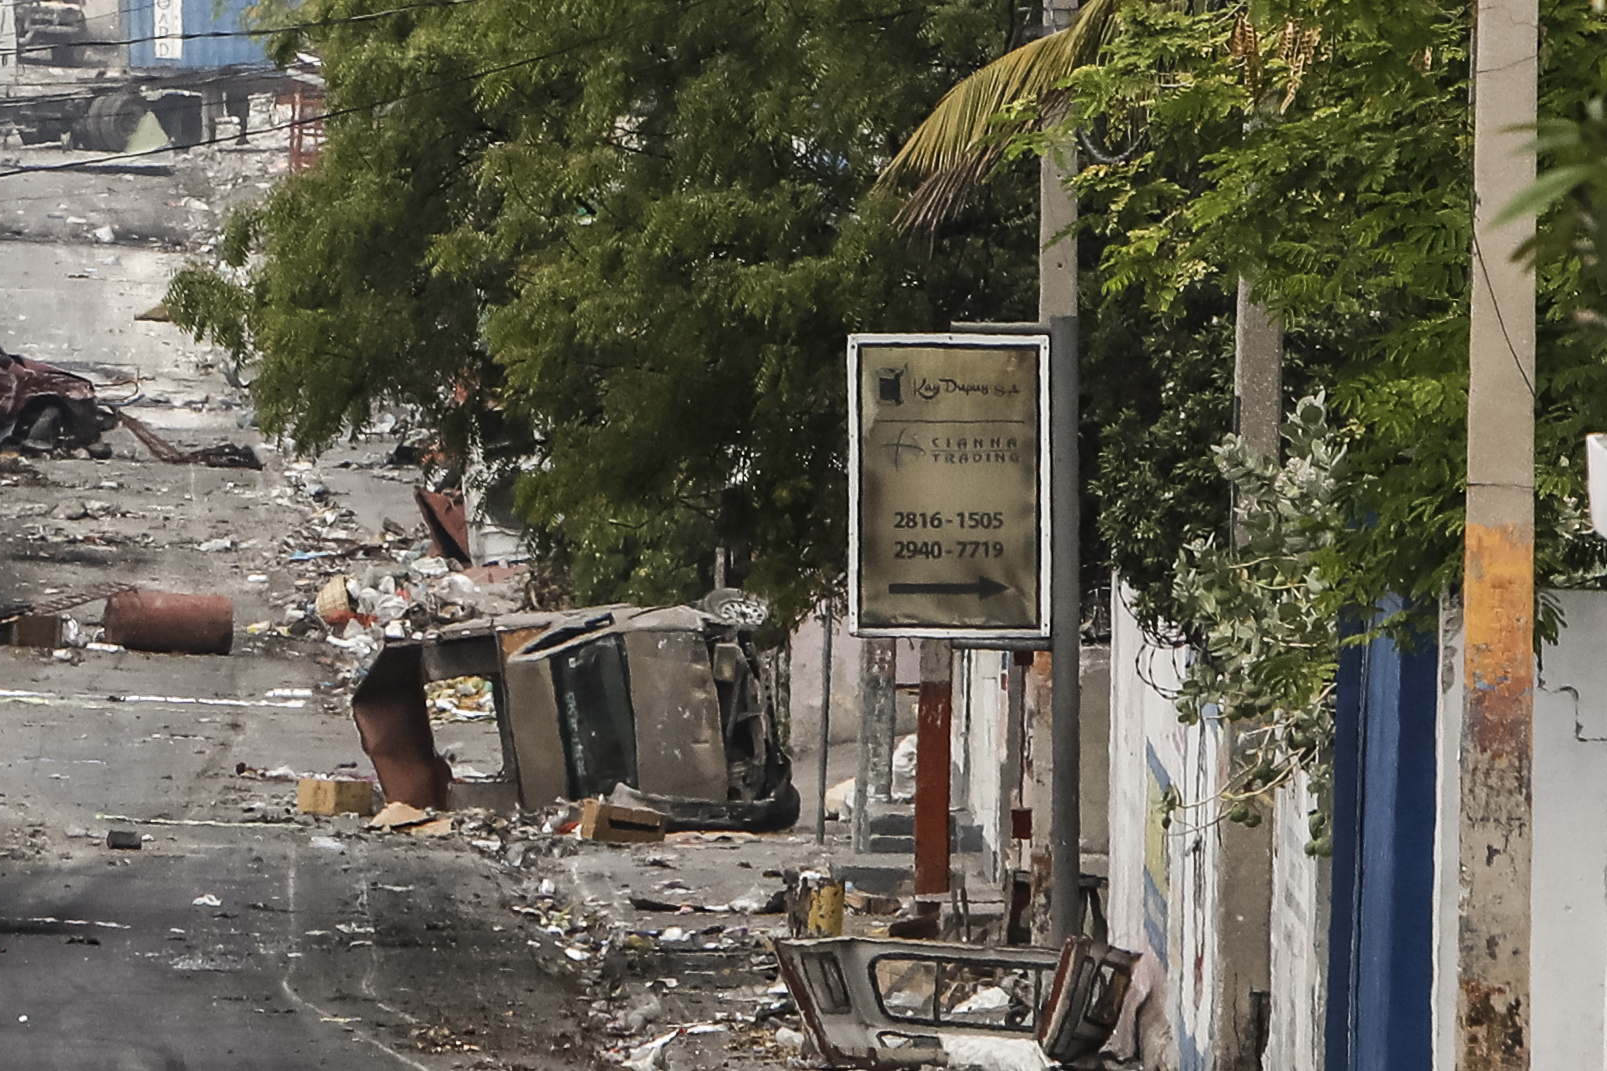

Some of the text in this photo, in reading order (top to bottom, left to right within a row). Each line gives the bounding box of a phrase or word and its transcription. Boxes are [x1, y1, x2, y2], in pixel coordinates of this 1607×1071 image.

[913, 377, 941, 400] Kay
[931, 436, 1018, 449] CIANNA
[931, 451, 1022, 464] TRADING
